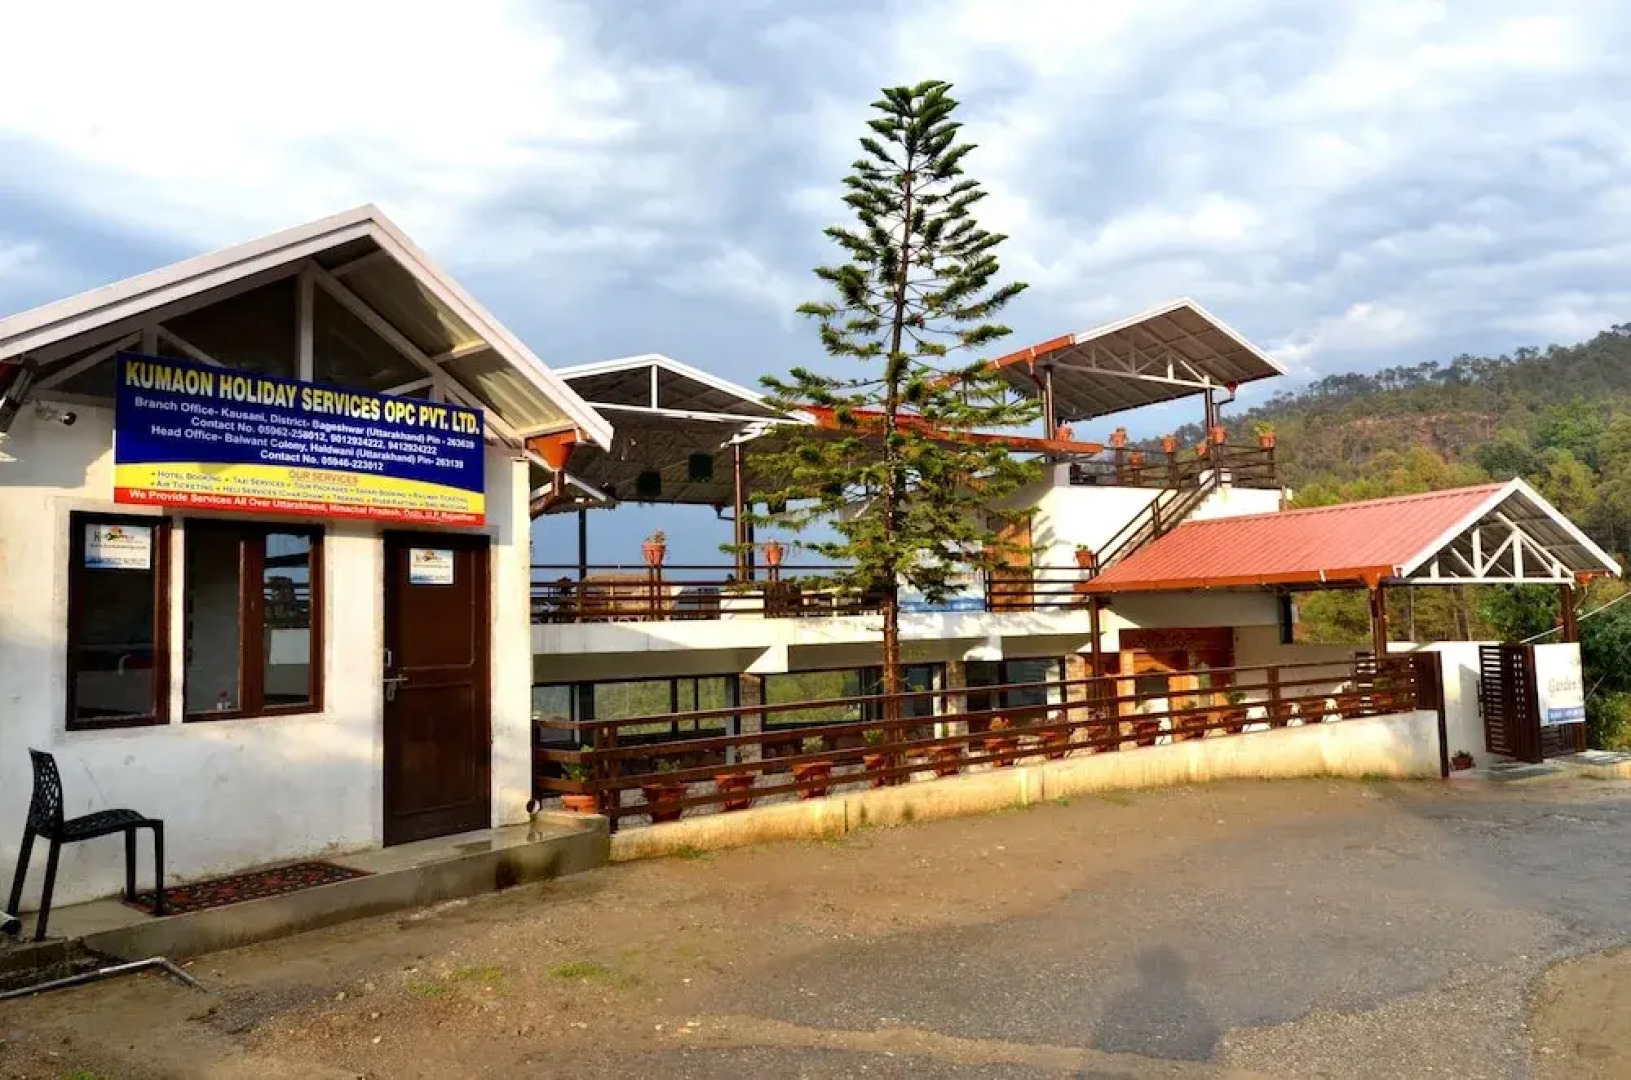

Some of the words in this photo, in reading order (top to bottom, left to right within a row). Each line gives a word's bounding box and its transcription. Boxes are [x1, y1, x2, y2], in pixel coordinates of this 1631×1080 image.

[126, 361, 213, 397] KUMAON
[219, 374, 298, 409] HOLIDAY
[301, 387, 381, 421] SERVICES
[384, 400, 416, 425] OPC
[418, 406, 449, 430] PVT.
[451, 411, 480, 435] LTD.
[134, 396, 178, 411] Branch
[312, 419, 365, 434] Bageshwar
[366, 427, 425, 444] (Uttarakhand)
[426, 434, 441, 444] Pin
[190, 416, 235, 431] Contact
[237, 422, 255, 433] No.
[151, 424, 182, 438] Head
[224, 433, 268, 447] Balwant
[270, 438, 309, 453] Colony,
[309, 443, 355, 456] Haldwani
[355, 448, 416, 466] (Uttarakhand)
[260, 449, 301, 463] Contact
[302, 455, 319, 466] No.
[288, 469, 311, 480] OUR
[312, 471, 359, 486] SERVICES
[129, 489, 146, 499] We
[148, 490, 188, 501] Provide
[190, 493, 232, 505] Services
[234, 496, 248, 506] All
[248, 497, 272, 508] Over
[273, 500, 329, 513] Uttarakhand,
[329, 504, 367, 514] Himachal
